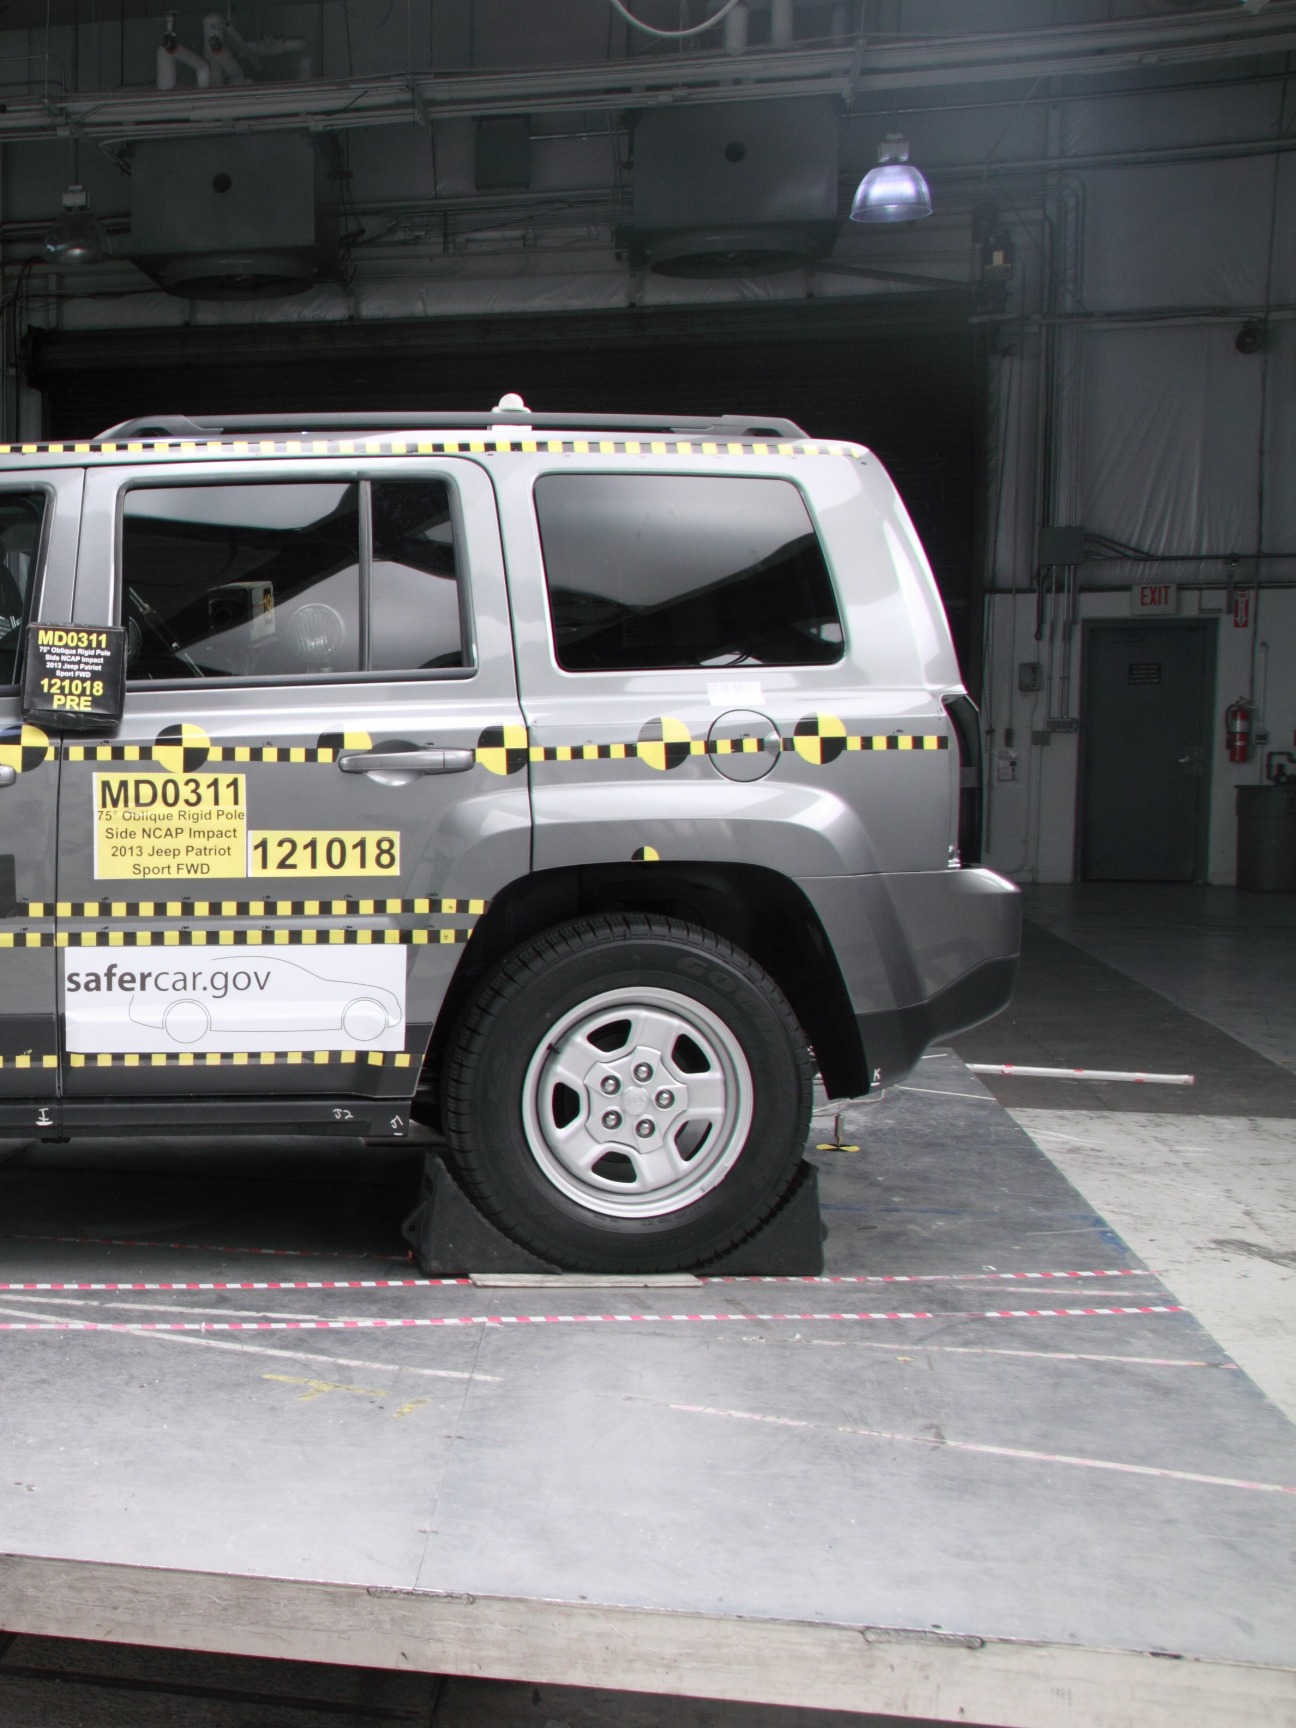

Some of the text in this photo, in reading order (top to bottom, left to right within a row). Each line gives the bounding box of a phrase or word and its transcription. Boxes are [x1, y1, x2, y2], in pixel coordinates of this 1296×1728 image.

[1140, 585, 1171, 606] EXIT
[38, 630, 107, 648] MD0311
[51, 647, 76, 655] Oblique
[77, 648, 95, 656] Rigid
[63, 663, 79, 671] Jeep
[81, 656, 104, 664] Impact
[40, 678, 103, 696] 121018
[52, 694, 92, 711] PRE
[101, 777, 239, 809] MD0311
[122, 810, 173, 823] Oblique
[178, 810, 212, 823] Rigid
[216, 809, 245, 821] Pole
[105, 827, 237, 841] Side NCAP Impact
[111, 845, 232, 859] 2013 Jeep Patriot
[253, 836, 396, 870] 121018
[132, 863, 210, 878] Sport FWD
[66, 963, 271, 999] safercar.gov
